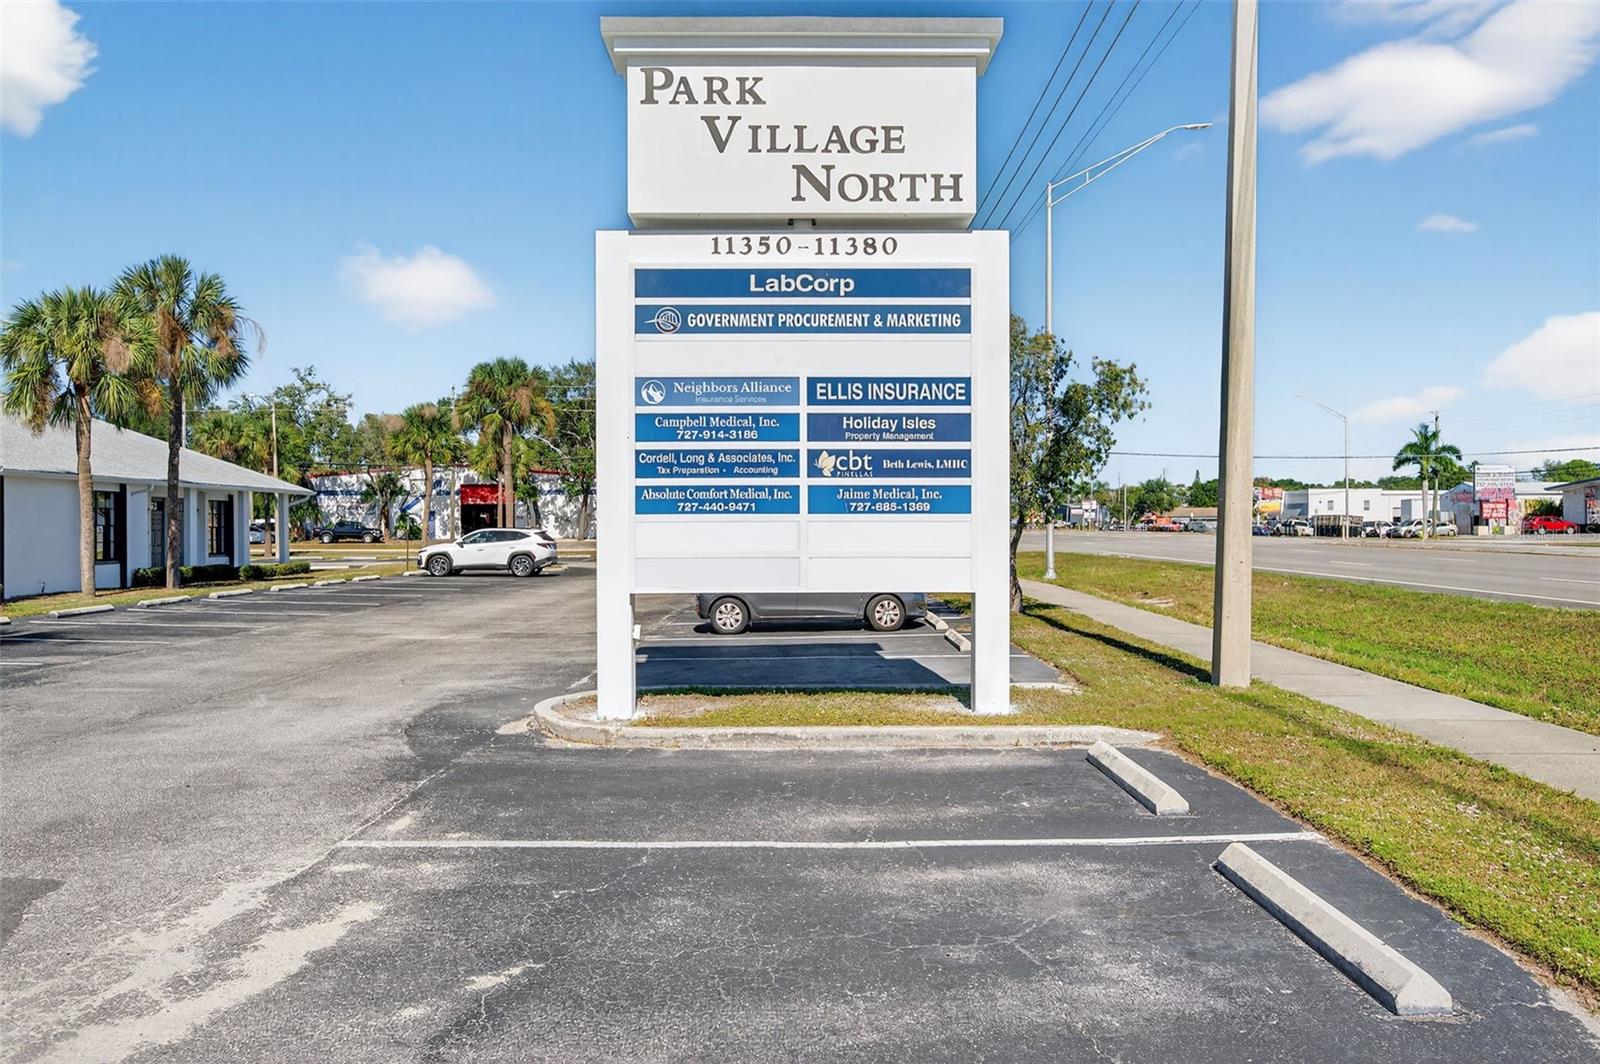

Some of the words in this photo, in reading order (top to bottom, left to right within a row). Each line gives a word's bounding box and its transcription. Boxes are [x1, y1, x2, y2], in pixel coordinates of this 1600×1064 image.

[640, 68, 766, 105] PARK
[701, 116, 905, 153] VILLAGE
[791, 164, 963, 202] NORTH
[749, 274, 854, 296] LabCorp
[687, 313, 773, 328] GOVERNMENT
[778, 313, 869, 328] PROCUREMENT
[874, 313, 883, 328] &
[887, 313, 961, 328] MARKETING
[674, 382, 738, 396] Neighbors
[741, 382, 792, 393] Alliance
[816, 383, 863, 400] ELLIS
[868, 383, 966, 400] INSURANCE
[655, 416, 707, 429] Campbell
[710, 416, 756, 428] Medical,
[759, 417, 780, 427] Inc.
[843, 416, 898, 432] Holiday
[903, 417, 936, 429] Isles
[676, 430, 758, 439] 727-914-3186
[845, 433, 880, 441] Property
[882, 433, 934, 441] Management
[639, 453, 677, 464] Cordell,
[680, 453, 705, 465] Long
[708, 454, 715, 463] &
[718, 453, 775, 464] Associates,
[778, 453, 796, 463] Inc.
[836, 450, 873, 470] cbt
[883, 459, 904, 469] Beth
[673, 467, 719, 475] Preparation
[734, 467, 778, 475] Accounting
[641, 489, 685, 500] Absolute
[687, 488, 728, 500] Comfort
[730, 489, 772, 501] Medical,
[774, 489, 792, 499] Inc.
[837, 489, 870, 499] Jaime
[873, 489, 918, 501] Medical,
[922, 489, 942, 499] Inc.
[677, 503, 756, 512] 727-440-9471
[850, 503, 930, 512] 727-685-1369
